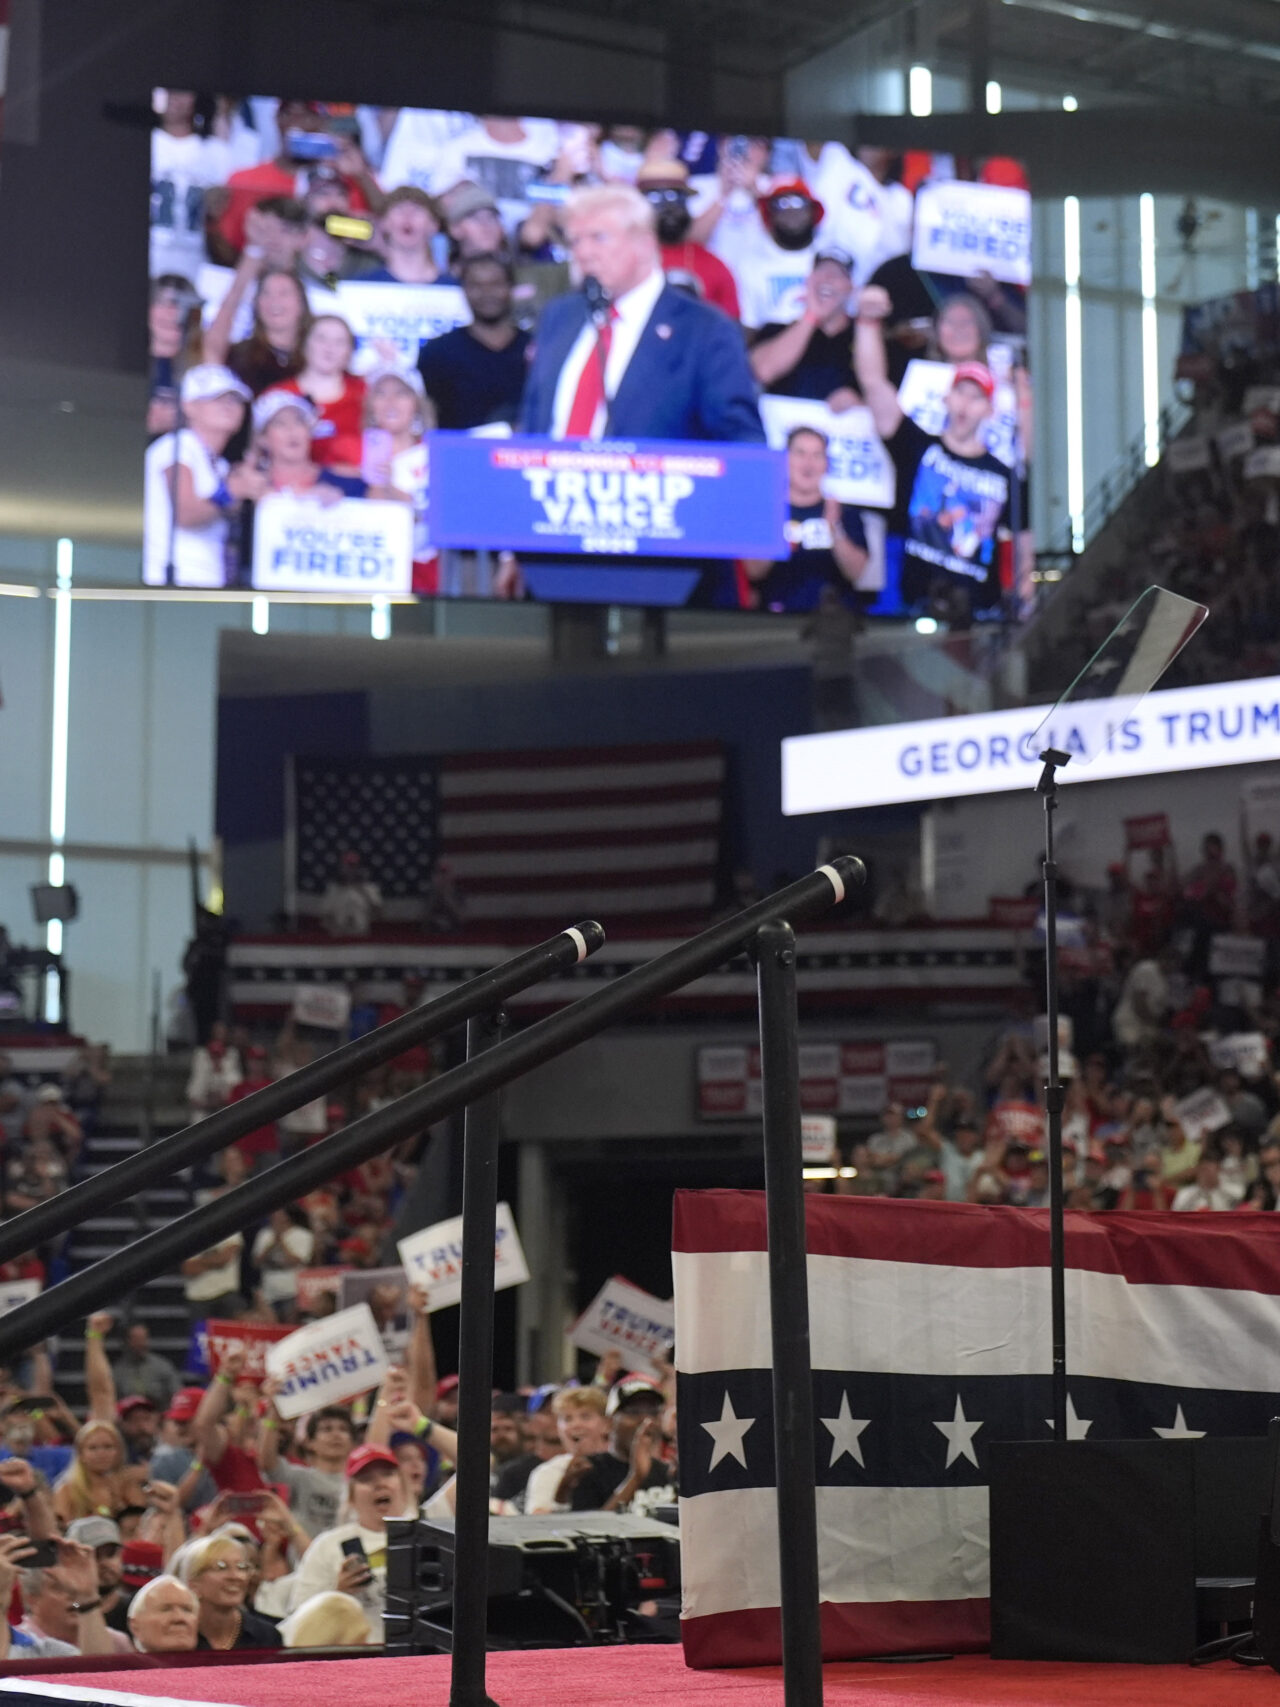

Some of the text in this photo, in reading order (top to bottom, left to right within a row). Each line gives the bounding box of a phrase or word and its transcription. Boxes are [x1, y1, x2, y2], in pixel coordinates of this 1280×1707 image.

[521, 468, 695, 503] TRUMP
[541, 499, 678, 530] VANCE
[283, 527, 386, 549] YOU'RE
[272, 549, 396, 582] FIRED!
[898, 725, 1087, 779] GEORGIA
[1106, 718, 1143, 753] IS
[414, 1228, 507, 1268] TRUP
[601, 1300, 674, 1342] TRUMP
[601, 1318, 659, 1354] VANCE
[277, 1349, 377, 1398] TRUMP
[286, 1337, 361, 1376] VANCE
